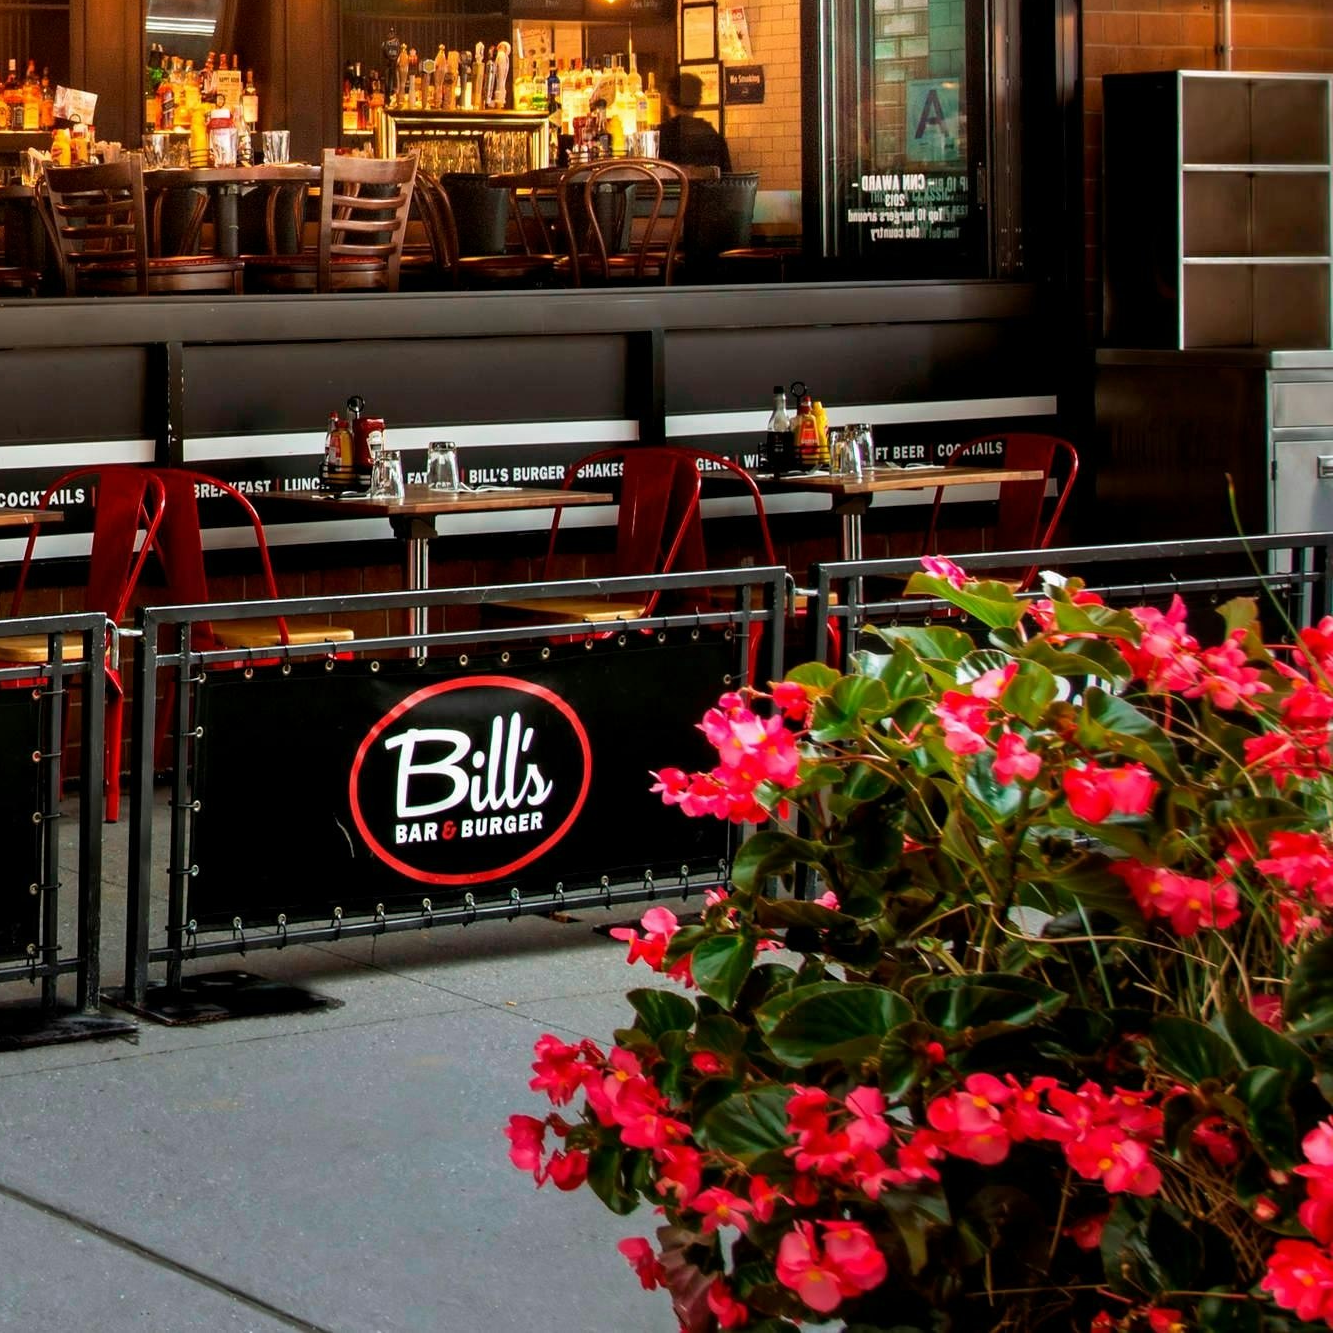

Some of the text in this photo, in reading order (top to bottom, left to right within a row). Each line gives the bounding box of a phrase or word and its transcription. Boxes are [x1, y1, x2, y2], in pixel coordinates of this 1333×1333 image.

[695, 455, 730, 472] GERS
[893, 445, 925, 459] BEER
[284, 476, 325, 492] LUNC
[469, 467, 509, 484] BILL'S
[513, 465, 565, 481] BURGER
[385, 711, 553, 818] Bill's
[395, 811, 543, 844] BAR & BURGER
